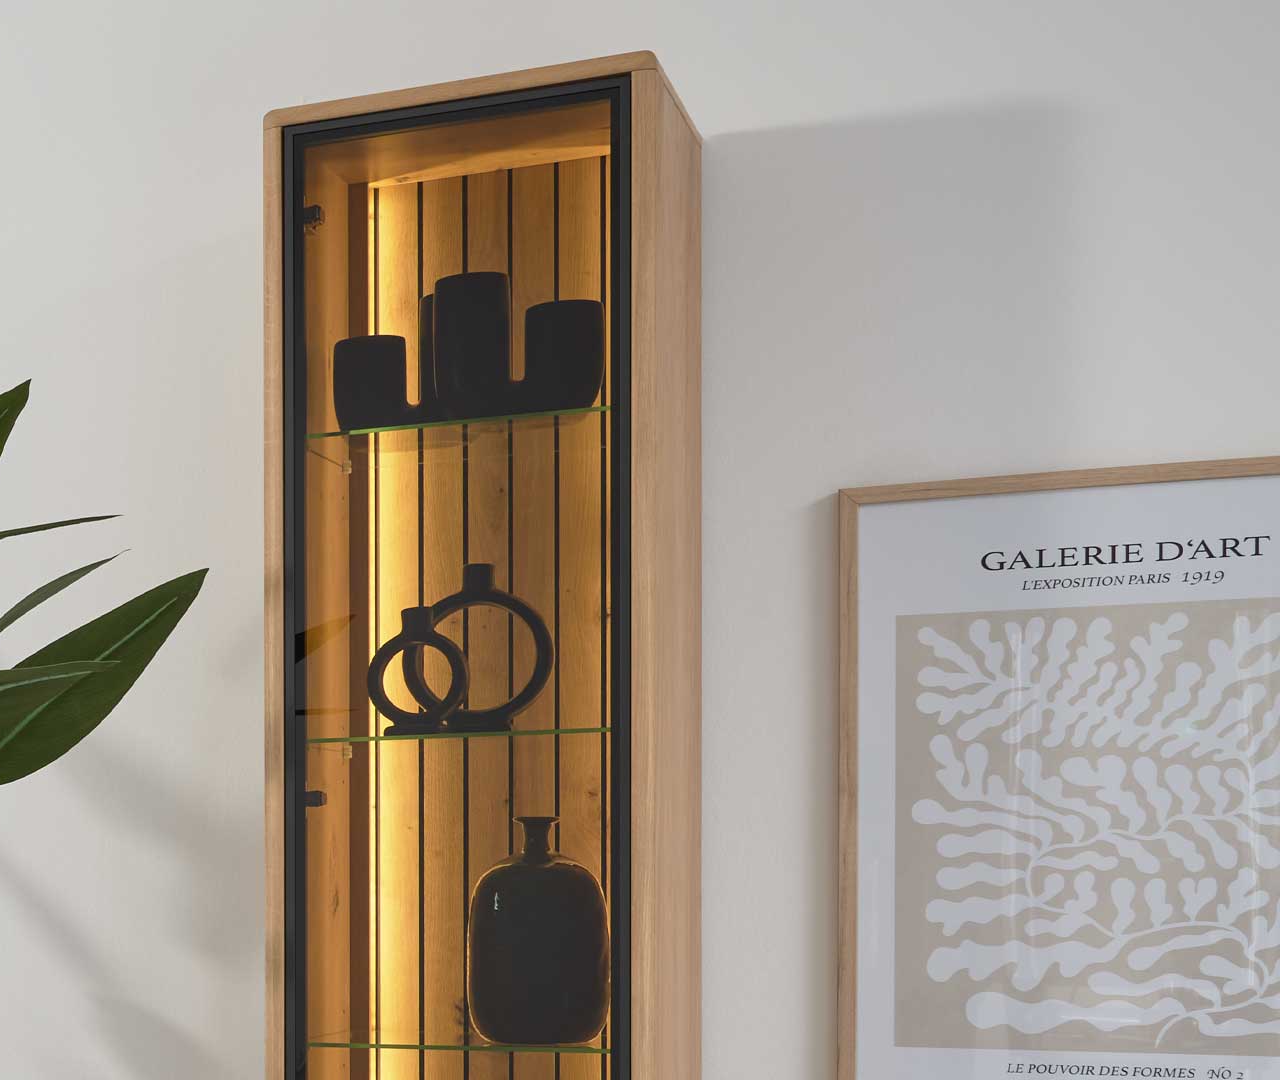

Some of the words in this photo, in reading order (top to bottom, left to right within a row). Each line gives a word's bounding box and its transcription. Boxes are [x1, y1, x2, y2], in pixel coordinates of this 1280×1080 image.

[980, 544, 1144, 571] GALERIE
[1155, 535, 1271, 562] D'ART
[1022, 575, 1125, 591] L'EXPOSITION
[1128, 573, 1171, 585] PARIS
[1182, 570, 1225, 586] 1919
[1007, 1063, 1024, 1074] LE
[1028, 1063, 1096, 1076] POUVOIR
[1099, 1065, 1129, 1077] DES
[1132, 1066, 1196, 1079] FORMES
[1236, 1071, 1244, 1080] 2
